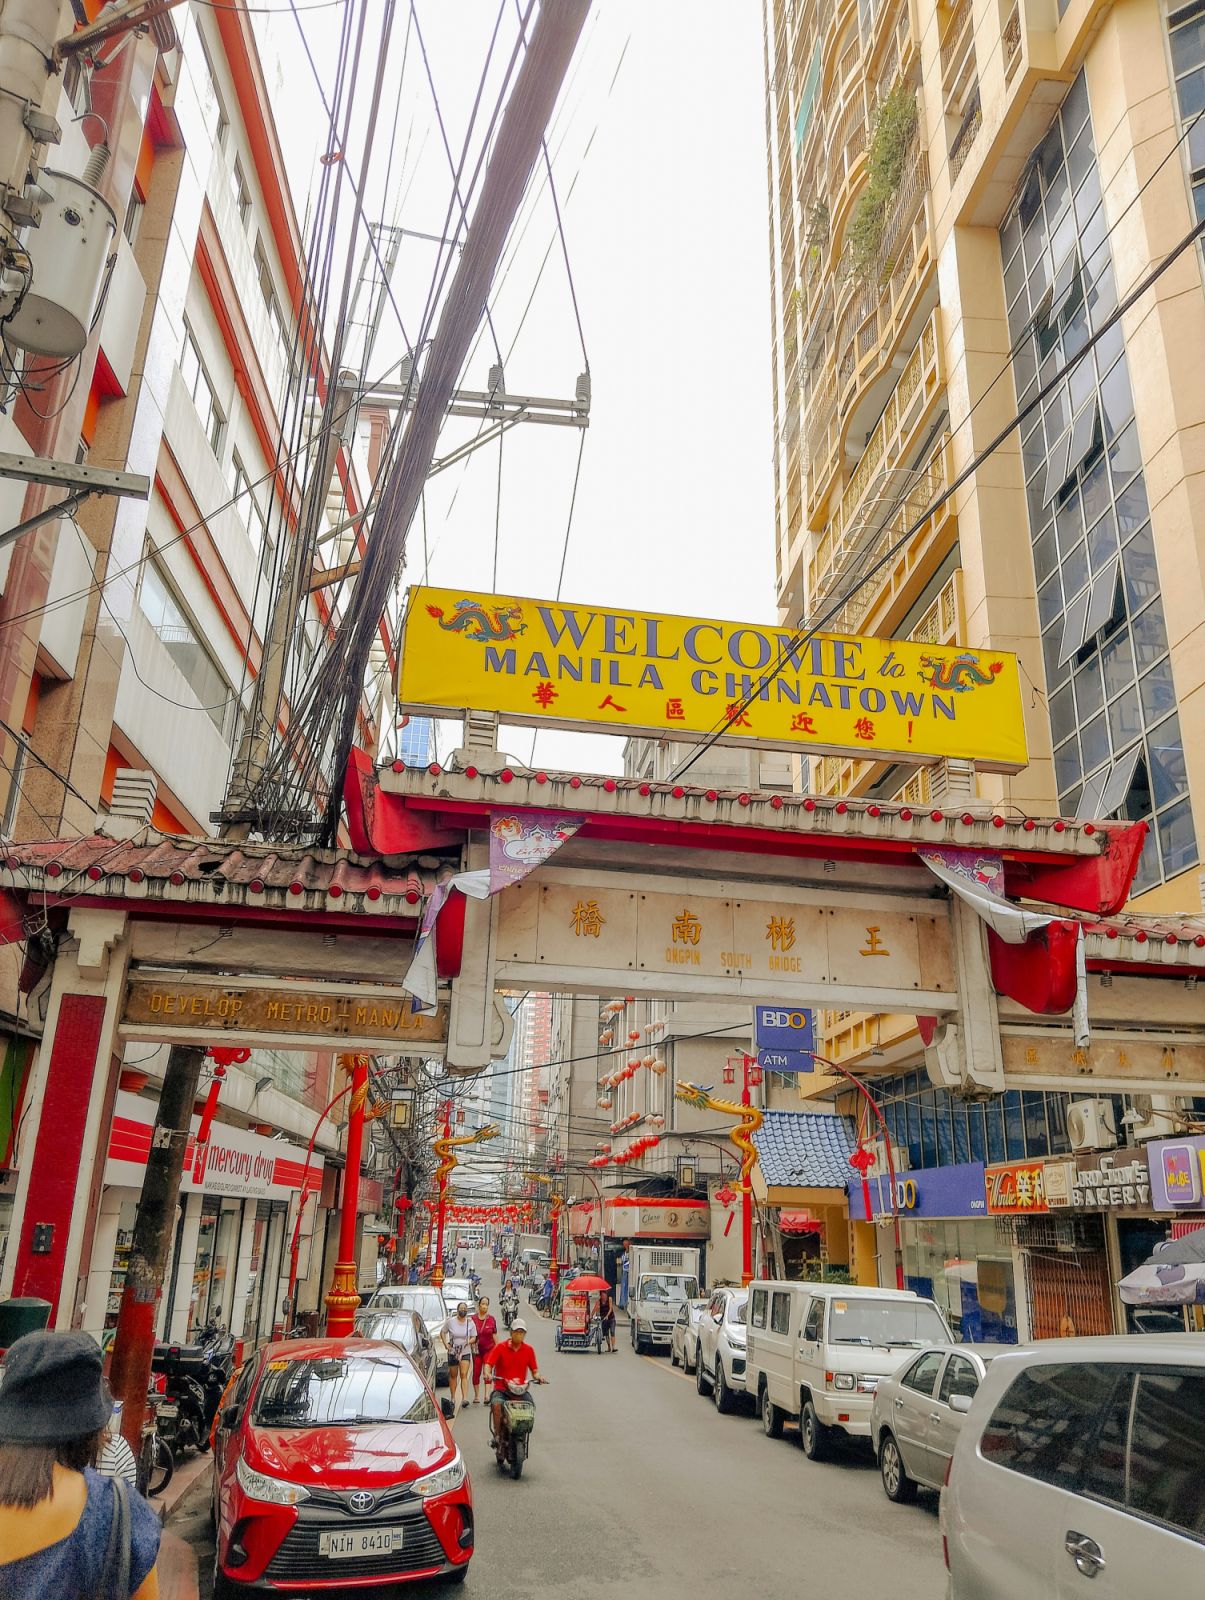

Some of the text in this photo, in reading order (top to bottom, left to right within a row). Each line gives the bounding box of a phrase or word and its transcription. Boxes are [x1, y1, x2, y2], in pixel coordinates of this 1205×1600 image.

[536, 606, 906, 681] WELCOME to
[484, 646, 956, 721] MANILA CHINATOWN
[665, 947, 803, 973] ONGPIN SOUTH BRIDGE
[149, 993, 243, 1018] DEVELOP
[762, 1010, 806, 1029] BDO
[763, 1054, 788, 1066] ATM
[207, 1144, 274, 1186] mercury drug
[1072, 1184, 1150, 1207] BAKERY
[331, 1537, 353, 1553] NIH
[361, 1534, 391, 1550] 8410
